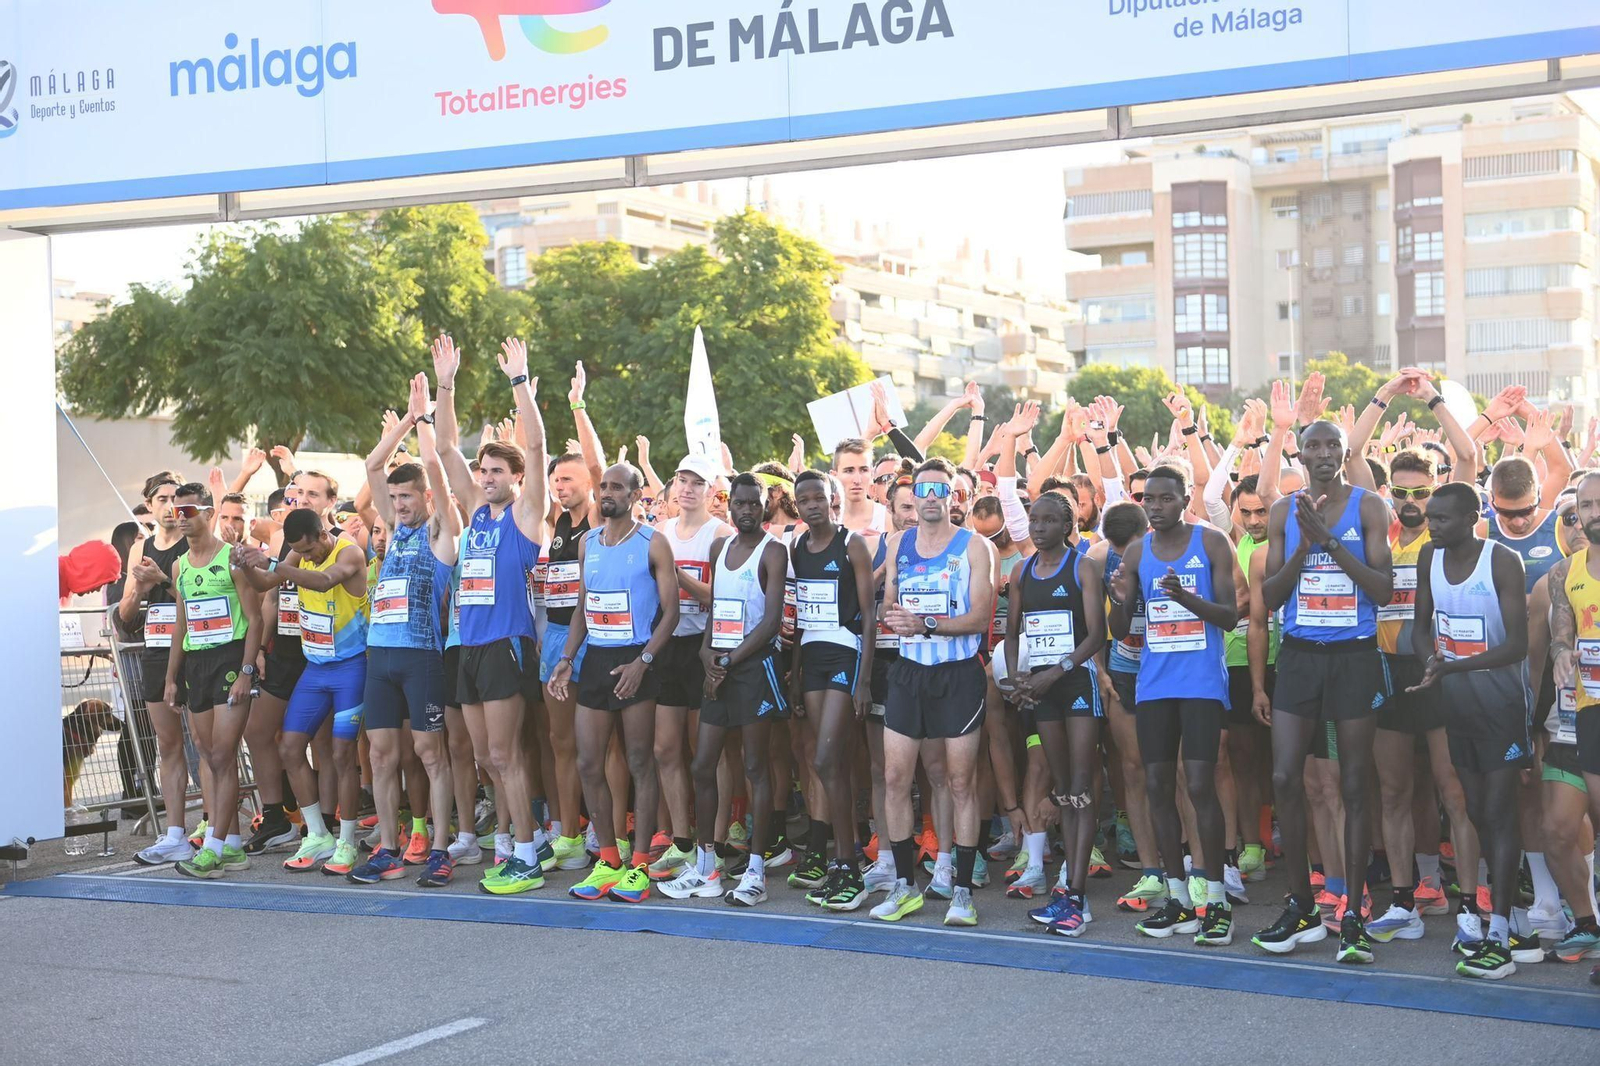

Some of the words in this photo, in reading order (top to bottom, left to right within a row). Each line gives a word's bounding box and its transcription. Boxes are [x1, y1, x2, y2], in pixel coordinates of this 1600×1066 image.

[1173, 17, 1204, 38] de
[1211, 7, 1303, 33] Málaga
[653, 21, 715, 72] DE
[729, 0, 955, 63] MÁLAGA
[169, 32, 358, 98] málaga
[30, 68, 115, 97] MÁLAGA
[434, 73, 627, 116] TotalEnergies
[30, 103, 67, 121] Deporte
[70, 105, 76, 119] y
[79, 98, 116, 115] Eventos
[467, 580, 474, 590] 24
[557, 584, 568, 593] 29
[1321, 597, 1328, 609] 4
[1394, 592, 1409, 603] 37
[381, 599, 391, 610] 26
[804, 605, 820, 614] F11
[287, 613, 297, 622] 39
[603, 614, 609, 624] 6
[155, 624, 166, 634] 65
[203, 620, 209, 630] 8
[716, 621, 722, 632] 3
[1170, 623, 1178, 635] 2
[306, 632, 315, 642] 63
[1035, 636, 1055, 648] F12
